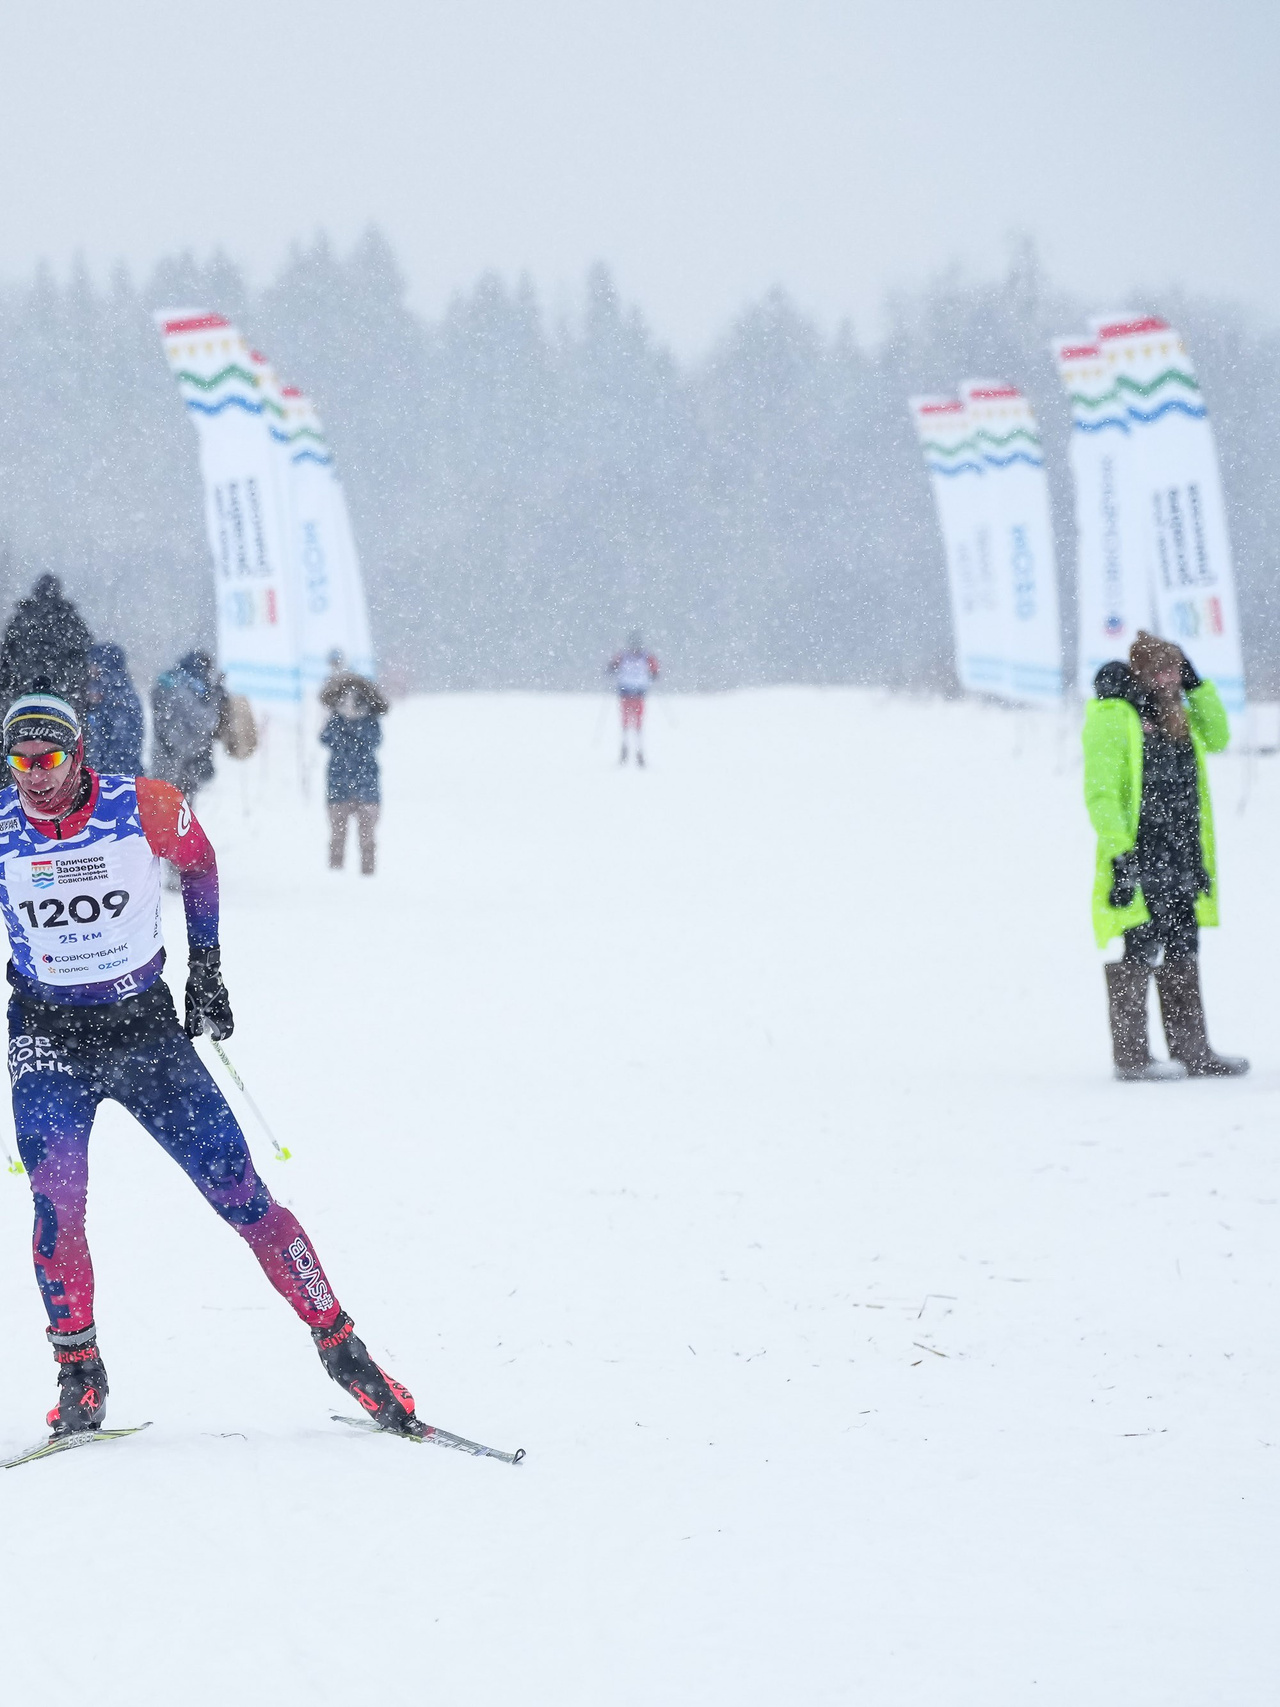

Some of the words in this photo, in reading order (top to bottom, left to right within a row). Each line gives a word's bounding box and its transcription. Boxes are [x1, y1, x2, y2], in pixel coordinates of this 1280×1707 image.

[55, 856, 104, 867] Галичское
[56, 863, 106, 874] Заозерье
[58, 874, 109, 885] СОВКОМБАНК
[18, 889, 130, 928] 1209
[59, 933, 78, 944] 25
[55, 942, 128, 963] СОВКОМБАНК
[98, 957, 128, 970] OZON
[288, 1237, 334, 1312] #SVCB
